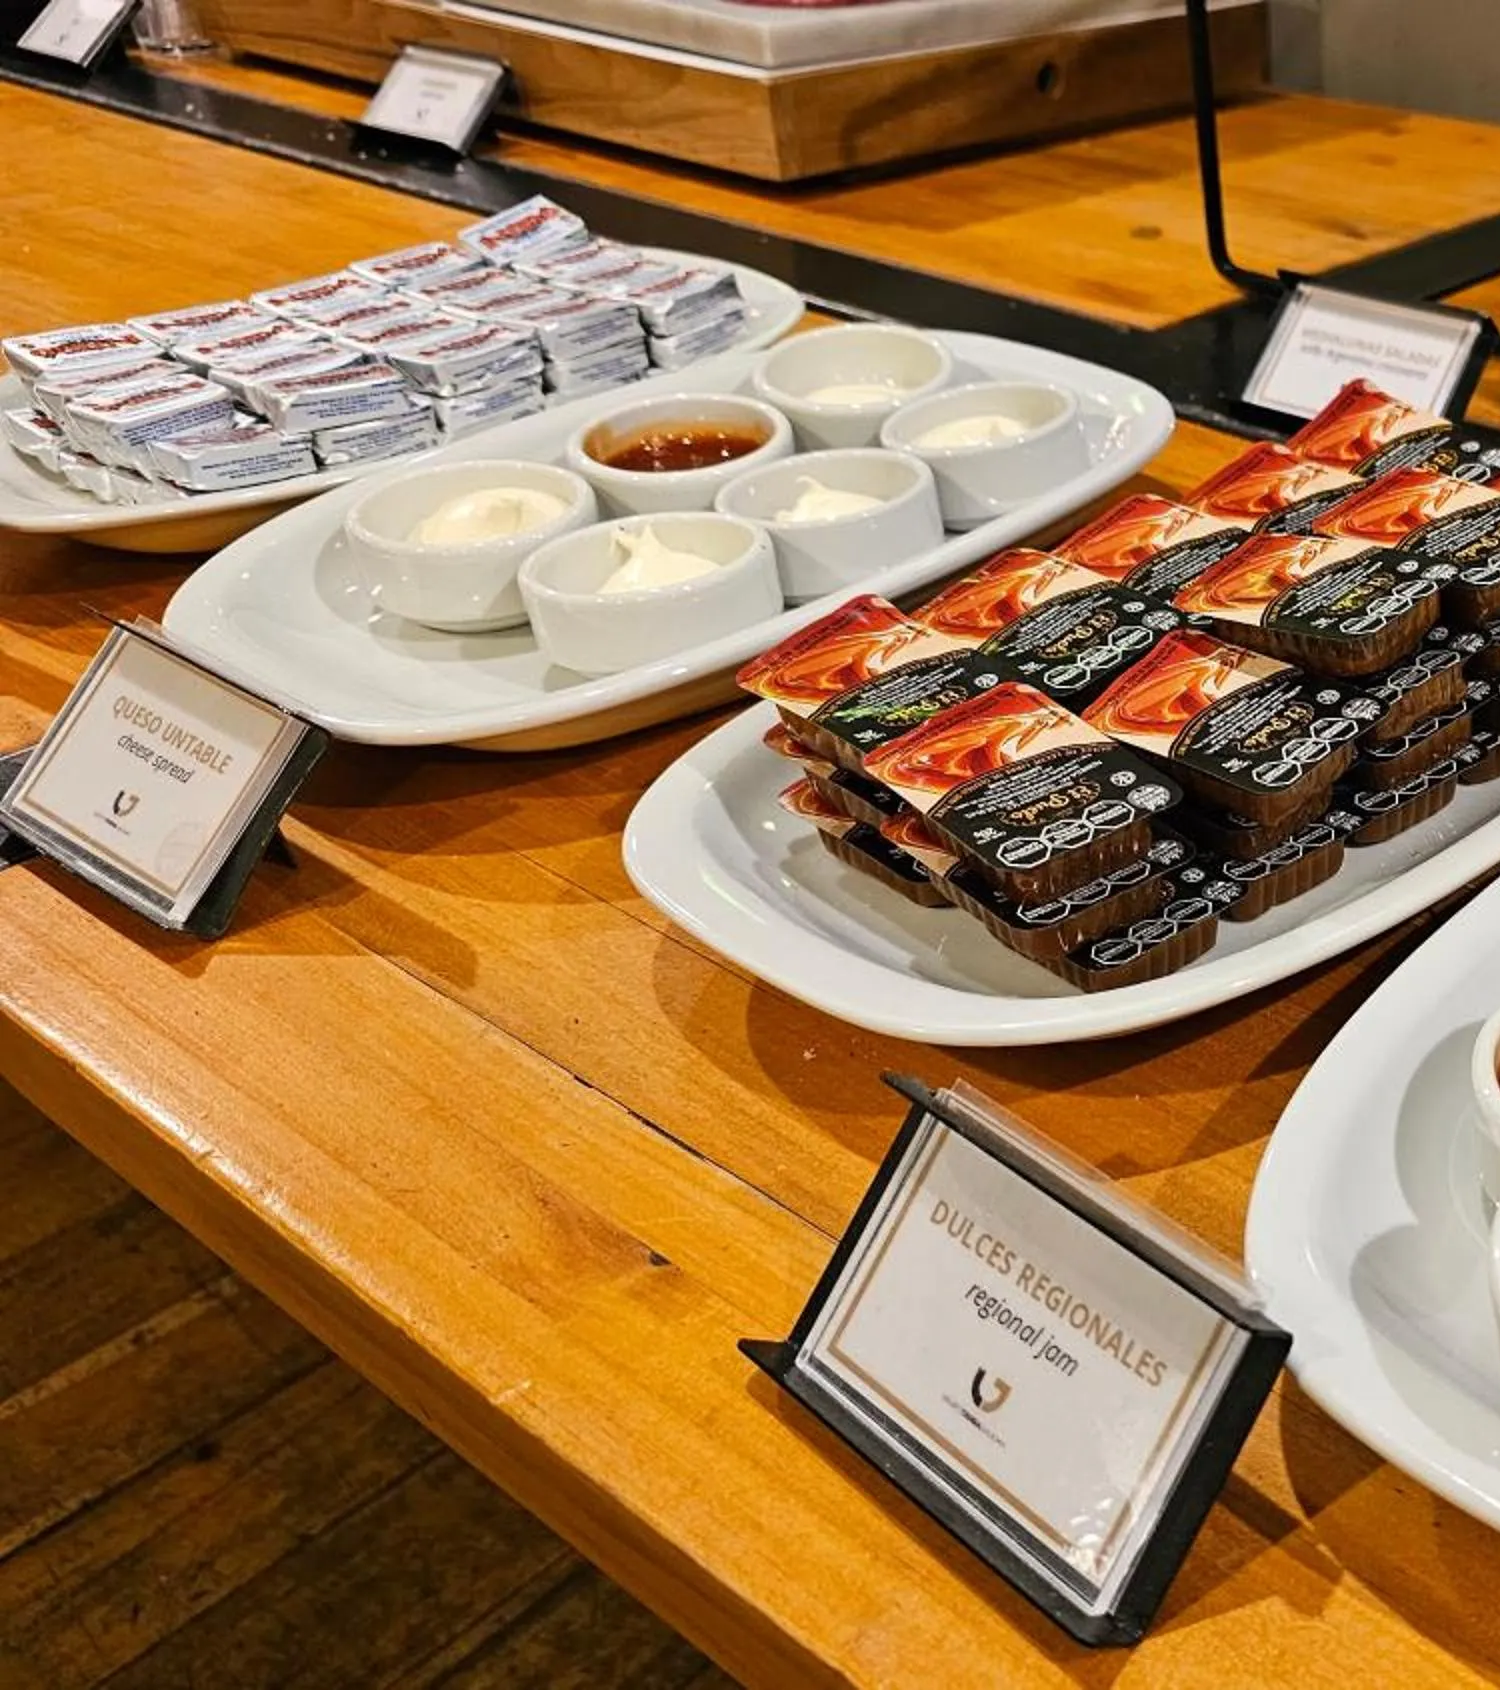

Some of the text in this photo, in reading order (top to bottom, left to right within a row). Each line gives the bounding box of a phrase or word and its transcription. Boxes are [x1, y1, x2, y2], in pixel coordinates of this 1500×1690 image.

[112, 696, 234, 774] QUESO UNTABLE
[117, 733, 196, 785] cheese spread
[929, 1199, 1169, 1388] DULCES REGIONALES
[964, 1283, 1080, 1378] regional jam
